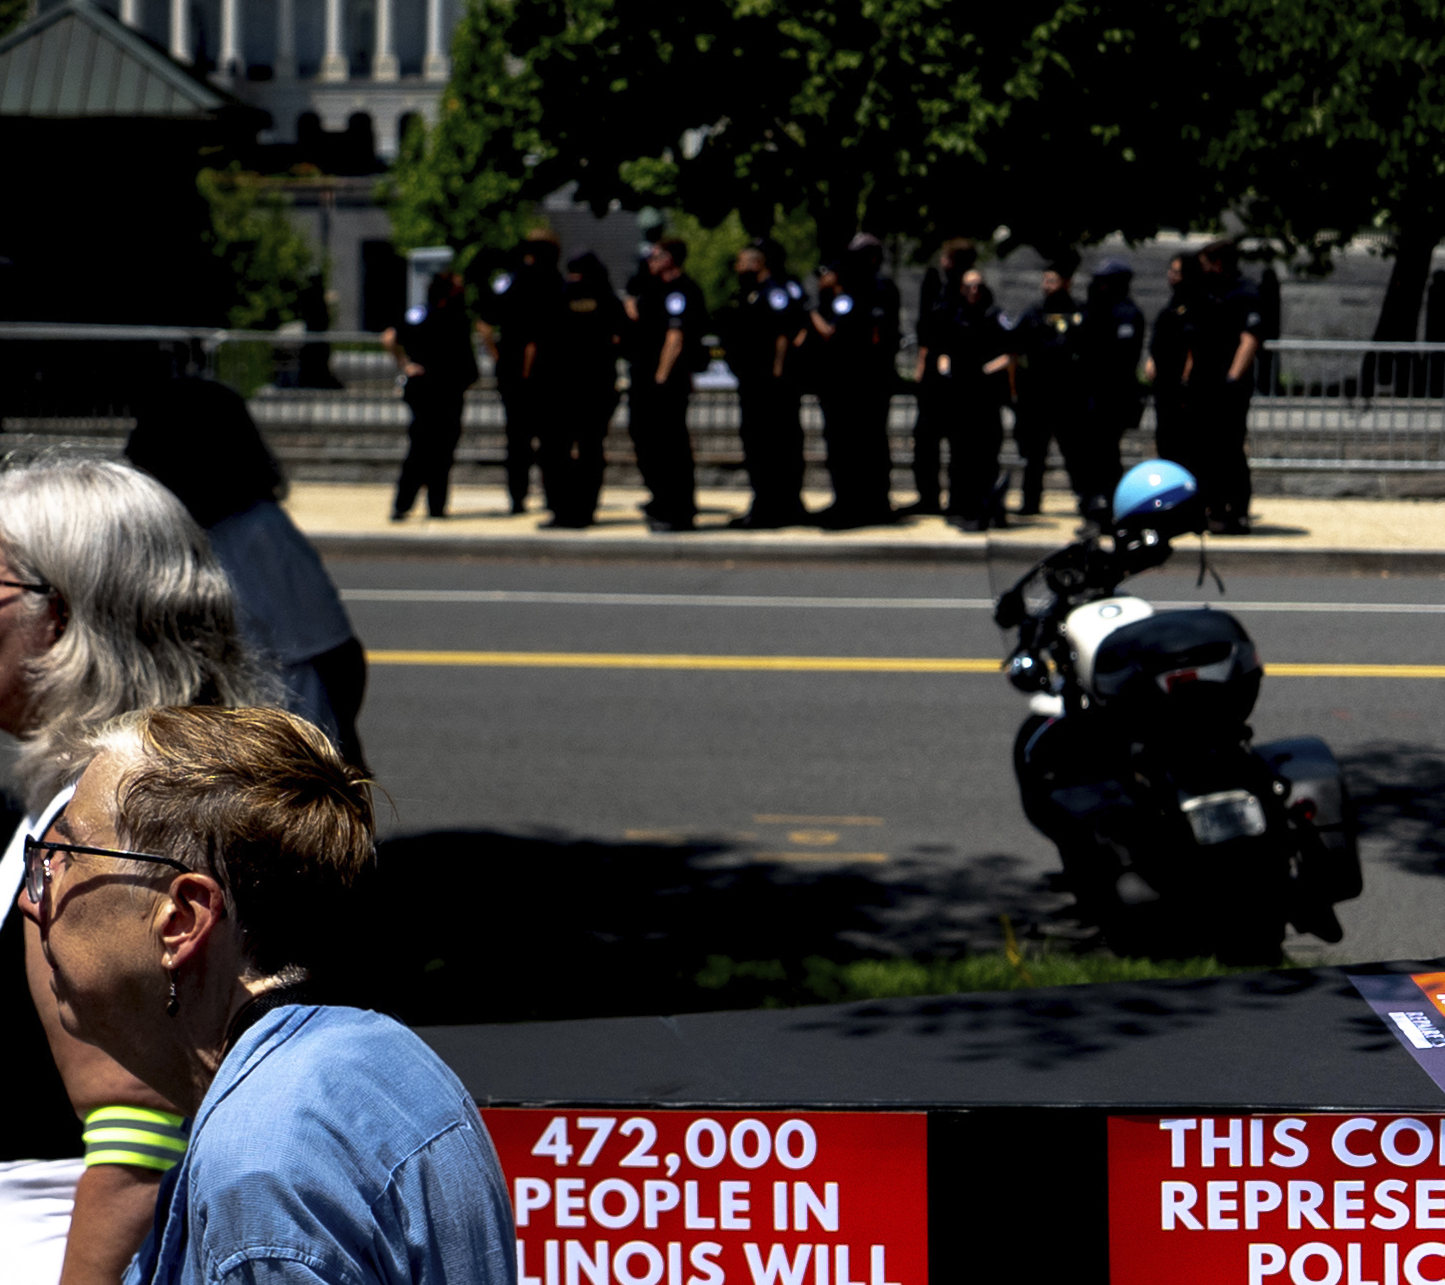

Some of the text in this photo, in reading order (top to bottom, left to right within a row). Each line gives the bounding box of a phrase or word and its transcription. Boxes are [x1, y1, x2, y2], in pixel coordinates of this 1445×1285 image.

[531, 1116, 817, 1177] 472,000
[1159, 1113, 1319, 1168] THIS
[514, 1177, 839, 1232] PEOPLE IN
